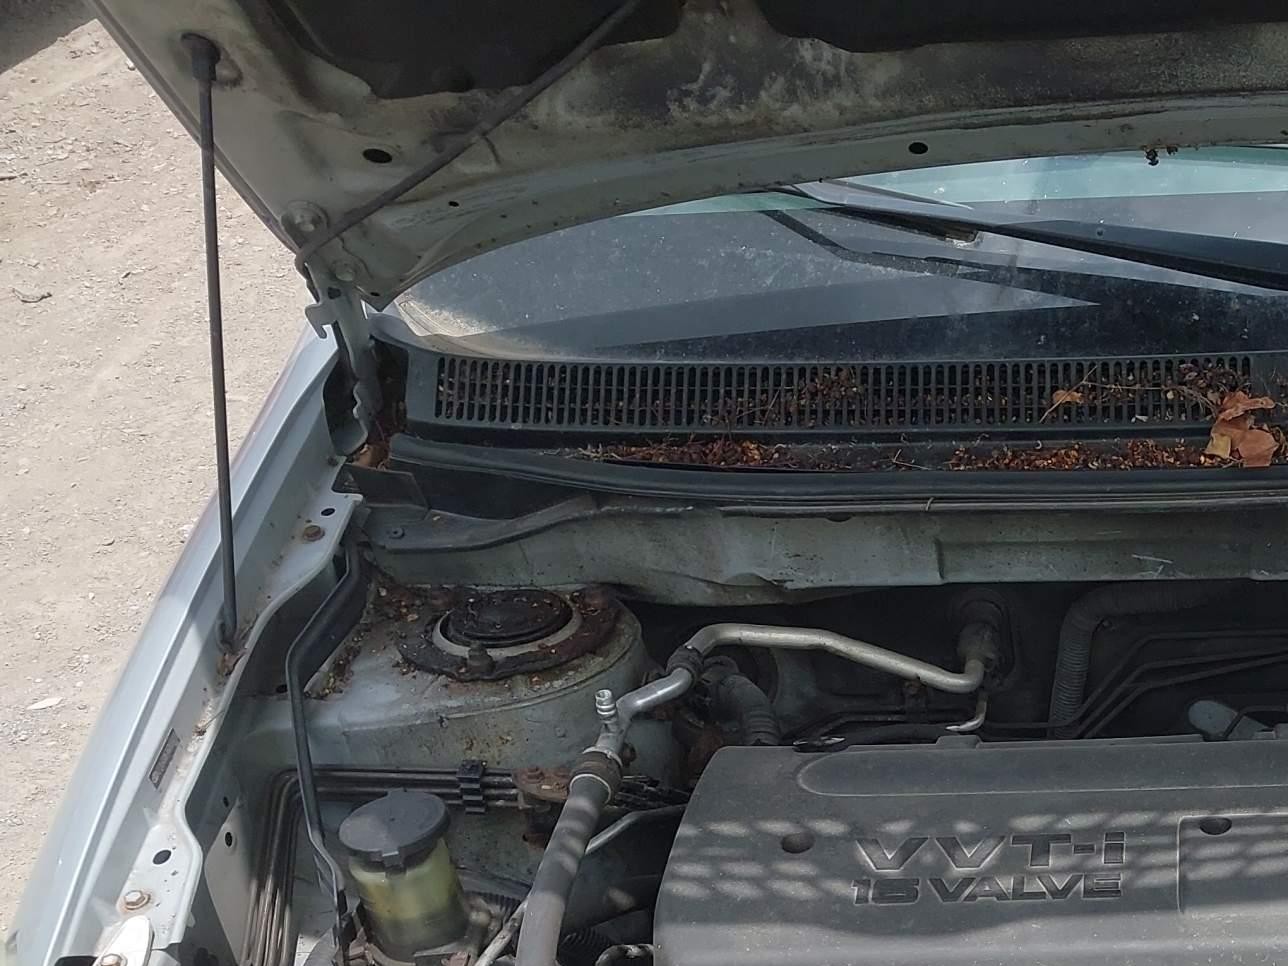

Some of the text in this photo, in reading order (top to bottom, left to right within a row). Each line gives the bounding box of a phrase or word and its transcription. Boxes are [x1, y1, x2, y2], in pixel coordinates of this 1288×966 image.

[855, 831, 1126, 872] VVT-i
[851, 873, 1122, 905] 16 VALVE
